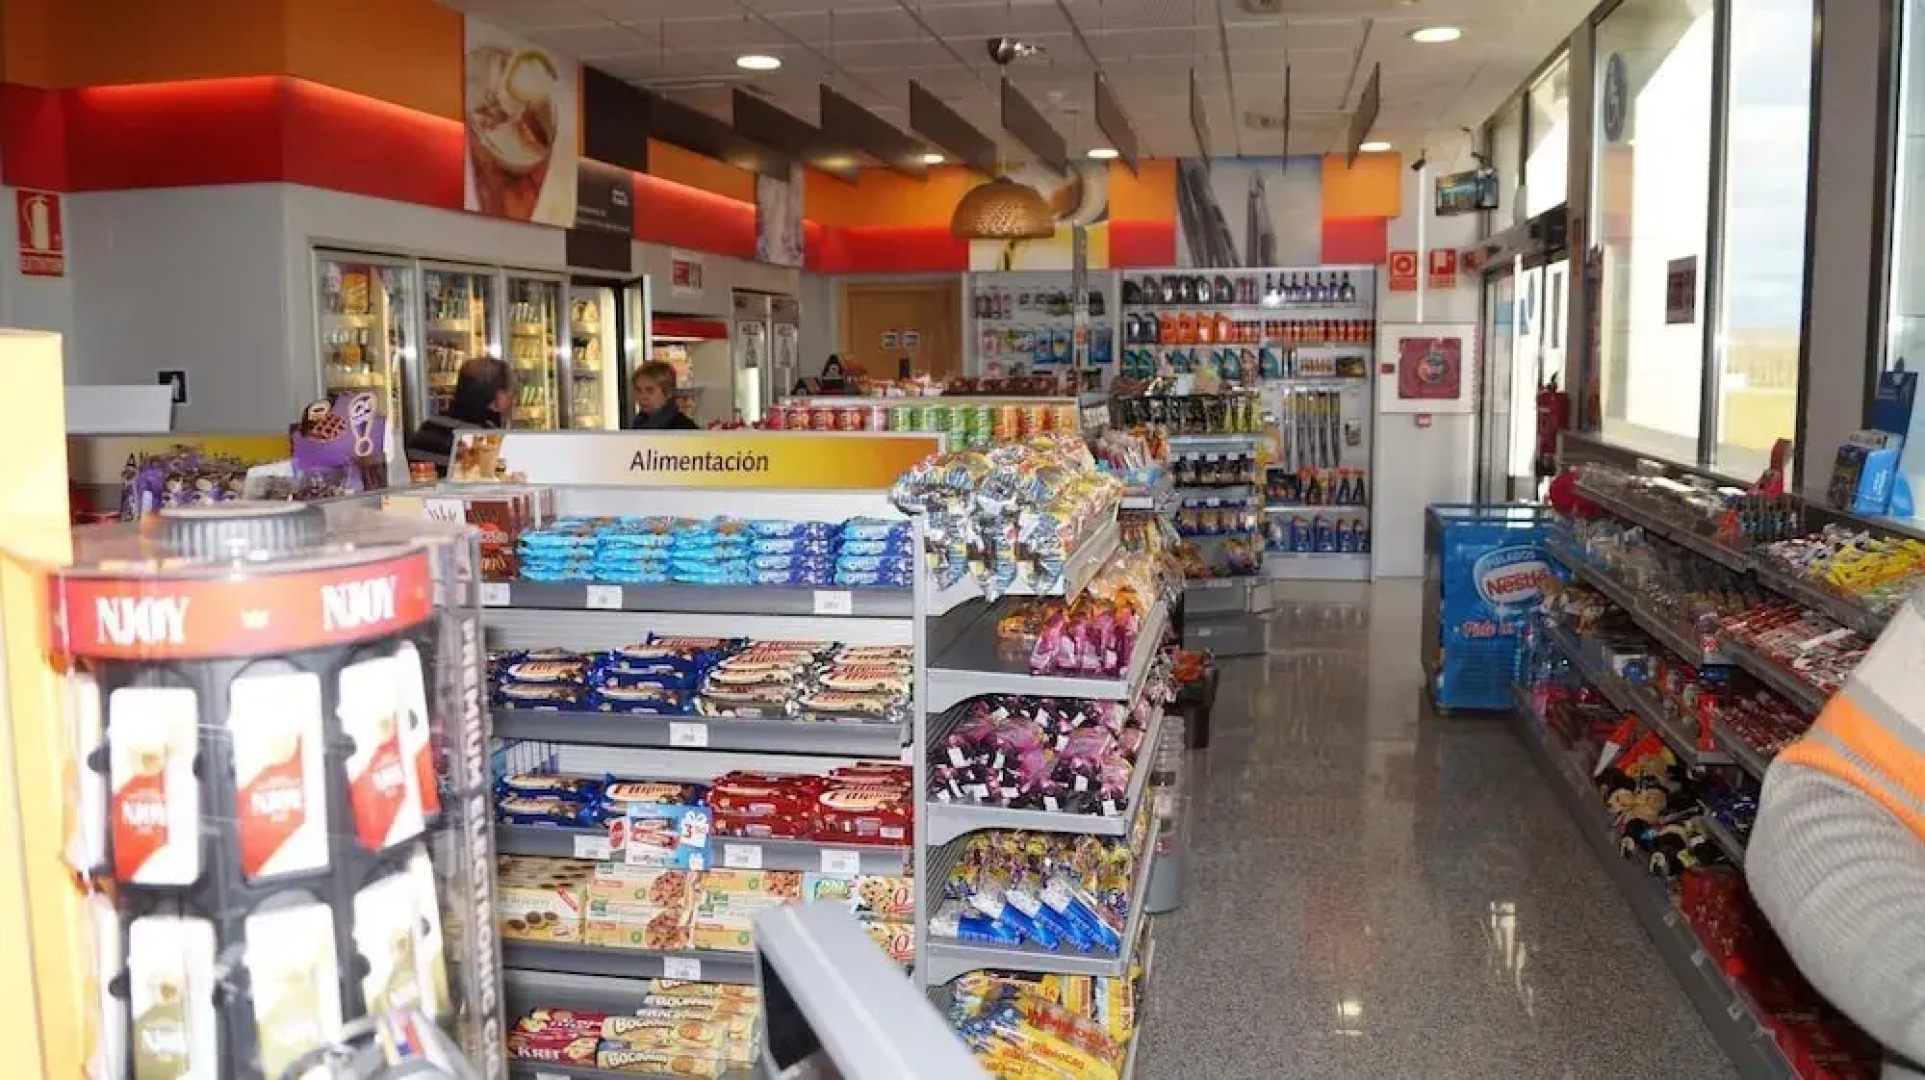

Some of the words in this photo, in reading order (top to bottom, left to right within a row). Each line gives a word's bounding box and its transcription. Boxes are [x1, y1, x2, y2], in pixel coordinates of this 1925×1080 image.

[629, 448, 769, 472] Alimentación
[96, 597, 190, 645] NJOY
[321, 576, 397, 632] NJOY
[461, 619, 484, 788] PREMIUM
[469, 794, 496, 1015] ELECTRONIC
[518, 1046, 560, 1060] KRIT
